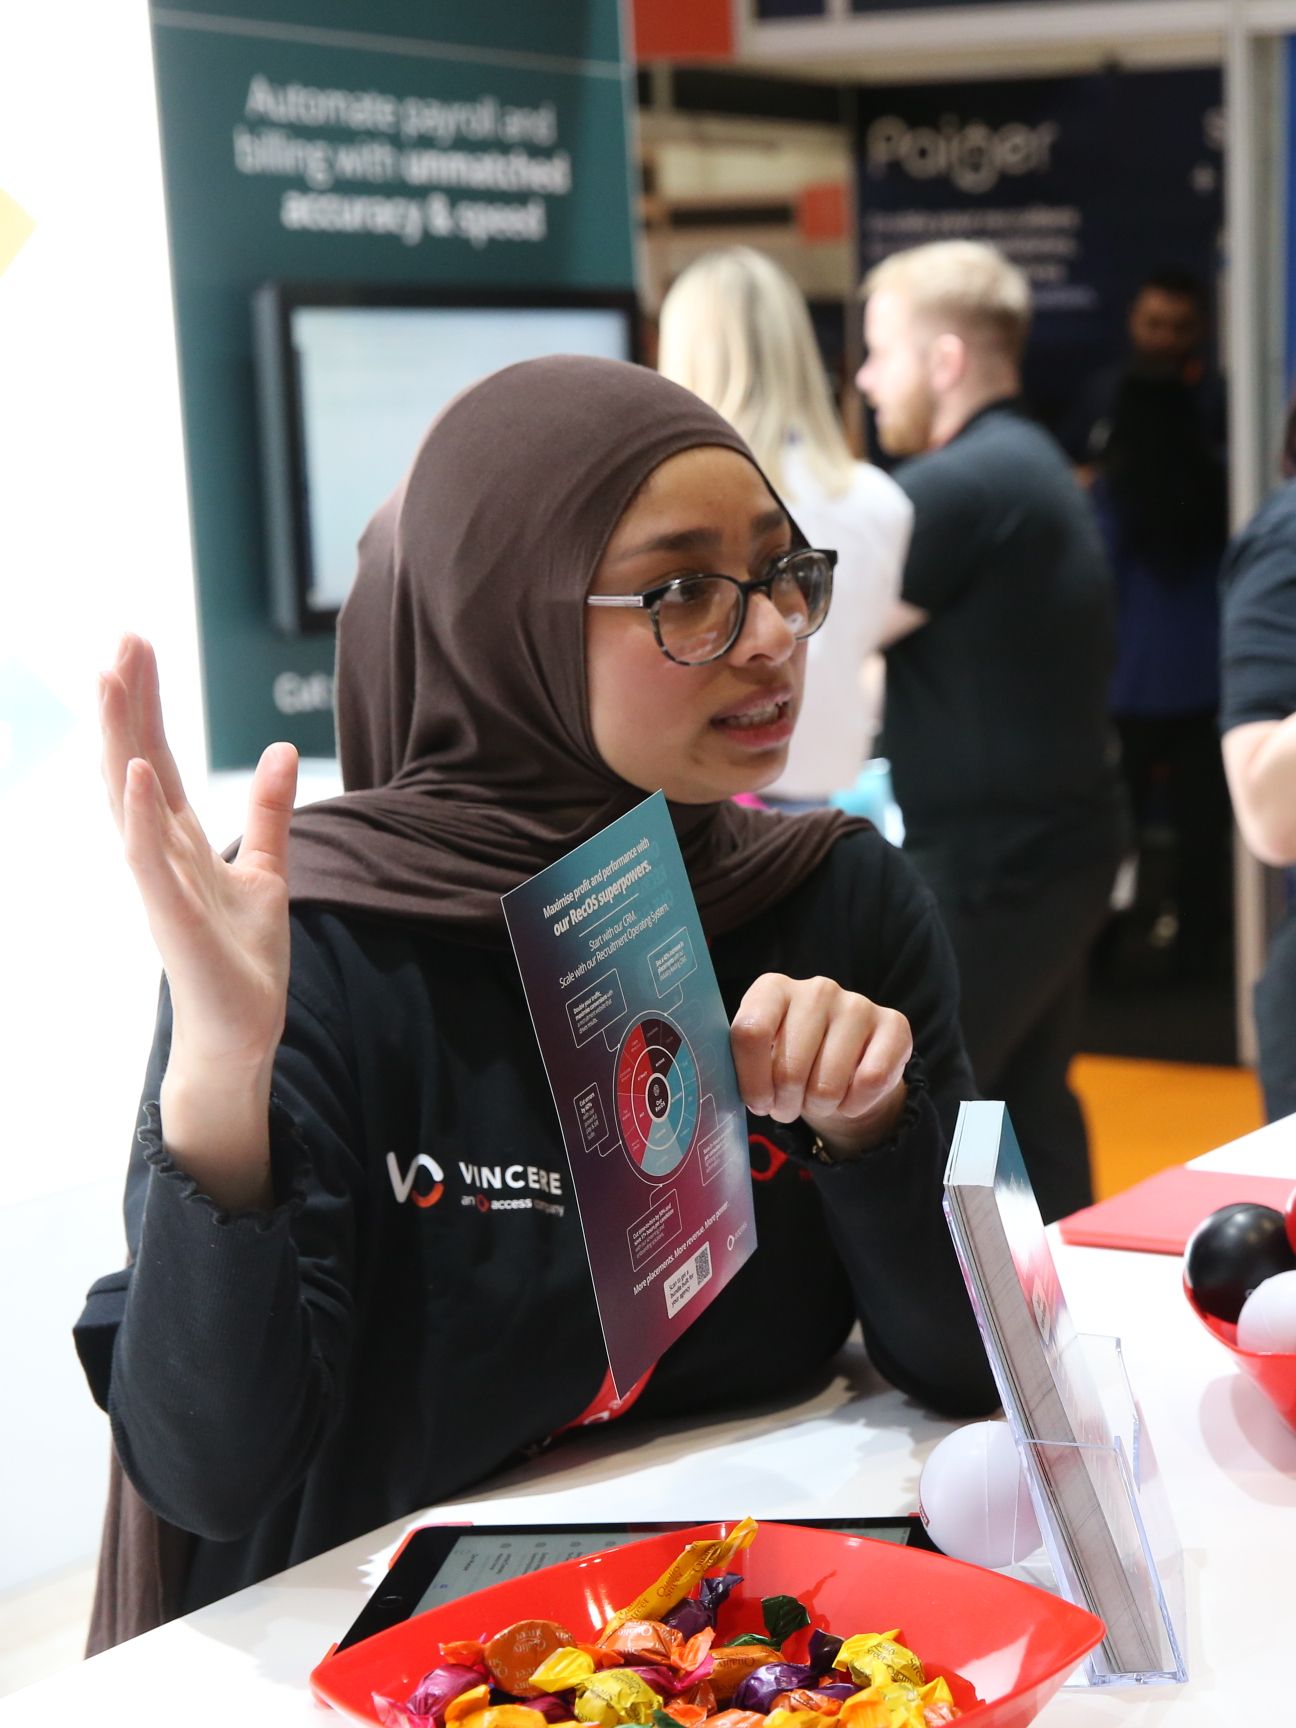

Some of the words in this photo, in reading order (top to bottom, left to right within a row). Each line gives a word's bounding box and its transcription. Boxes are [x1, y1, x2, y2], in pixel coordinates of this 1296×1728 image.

[246, 74, 399, 132] Automate
[400, 94, 497, 147] payroll
[503, 102, 556, 146] and
[233, 124, 334, 189] billing
[335, 138, 399, 182] with
[281, 190, 424, 246] accuracy
[454, 197, 546, 249] speed
[543, 892, 574, 919] Maximise
[573, 879, 591, 901] profit
[590, 869, 603, 886] and
[602, 847, 637, 881] performance
[636, 837, 650, 853] with
[554, 916, 570, 936] our
[569, 894, 598, 925] RecOS
[598, 860, 652, 906] superpowers.
[559, 971, 575, 989] Scale
[574, 962, 587, 978] with
[586, 956, 596, 969] our
[596, 933, 629, 962] Recruitment
[627, 916, 652, 939] Operating
[650, 903, 669, 922] System.
[589, 935, 603, 952] Start
[602, 927, 614, 942] with
[613, 921, 623, 934] our
[459, 1161, 562, 1195] VINCERE
[491, 1198, 532, 1210] access
[633, 1279, 647, 1295] More
[646, 1255, 675, 1286] placements.
[674, 1243, 687, 1258] More
[686, 1226, 705, 1247] revenue.
[704, 1214, 716, 1229] More
